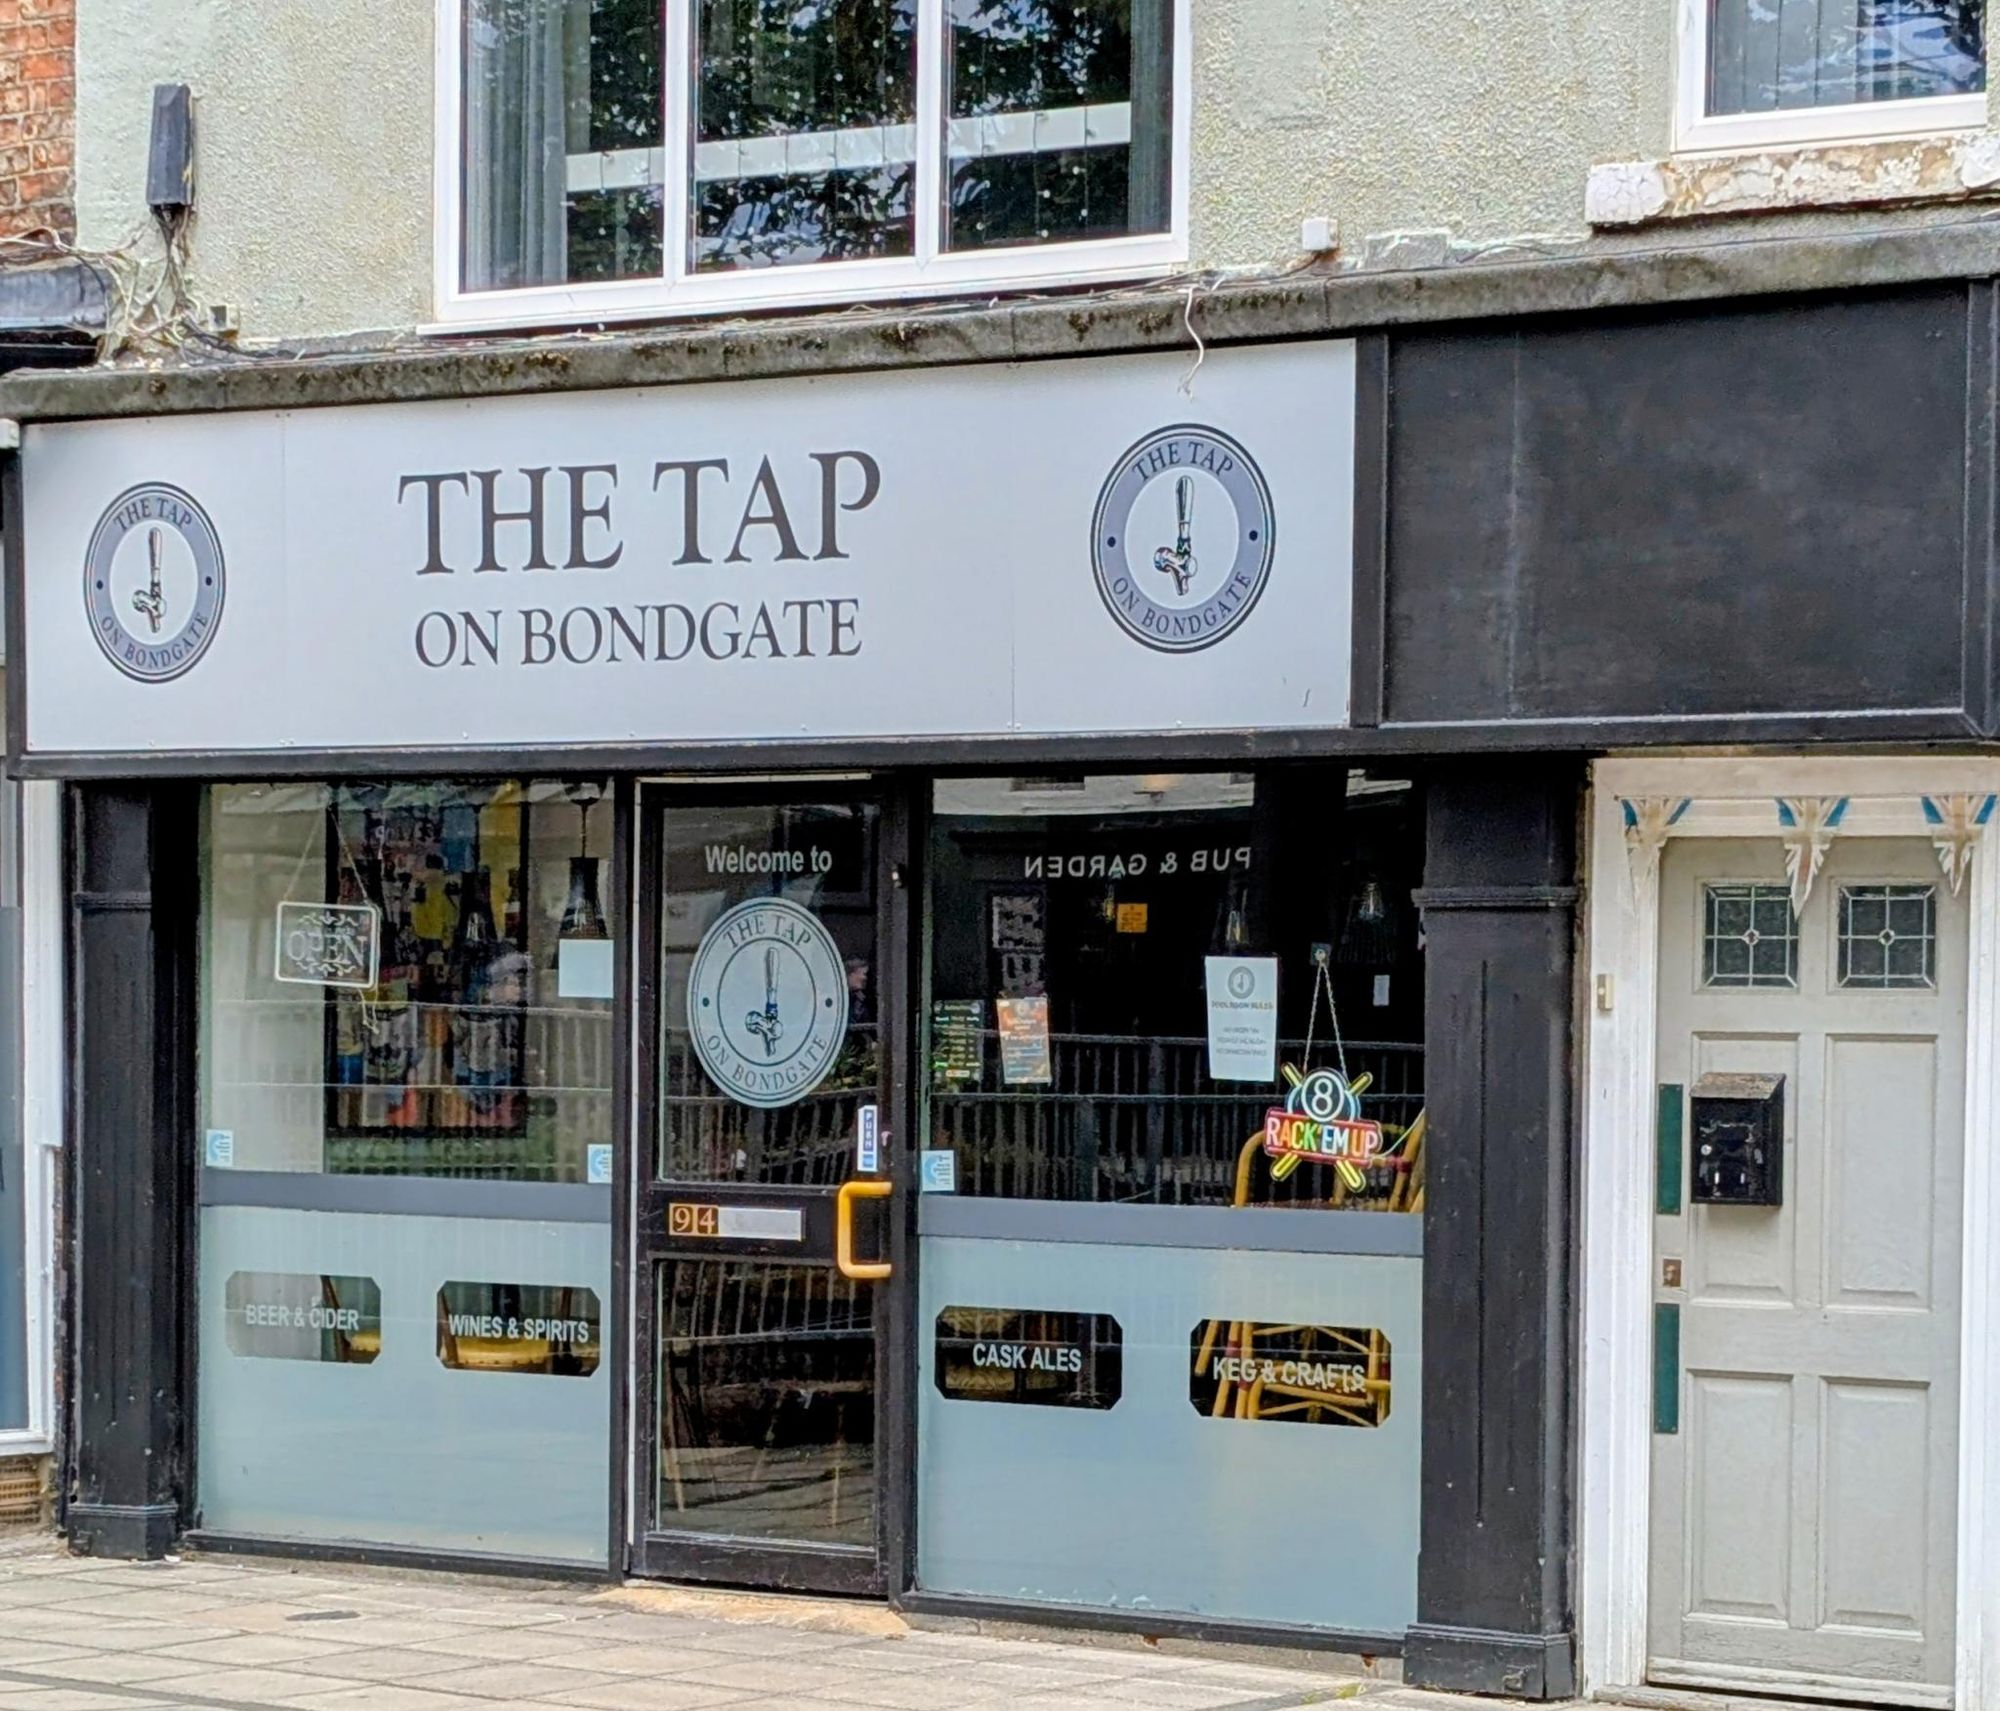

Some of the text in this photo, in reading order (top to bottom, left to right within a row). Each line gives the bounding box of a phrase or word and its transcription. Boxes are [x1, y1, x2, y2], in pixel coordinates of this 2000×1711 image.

[1132, 441, 1234, 482] THE TAP
[113, 497, 193, 533] THE TAP
[397, 450, 881, 576] THE TAP
[1112, 571, 1252, 637] ON BONDGATE
[101, 612, 209, 669] ON BONDGATE
[414, 597, 863, 668] ON BONDGATE
[704, 844, 833, 874] Welcome to
[286, 930, 368, 968] OPEN
[723, 913, 813, 949] THE TAP
[707, 1034, 828, 1090] ON BONDGATE
[1311, 1077, 1334, 1116] 8
[1351, 1127, 1379, 1159] UP
[674, 1207, 716, 1235] 94
[245, 1303, 360, 1331] BEER & CIDER
[449, 1313, 590, 1344] WINES & SPIRITS
[972, 1342, 1083, 1373] CASK ALES
[1212, 1355, 1366, 1391] KEG & CRAFTS
